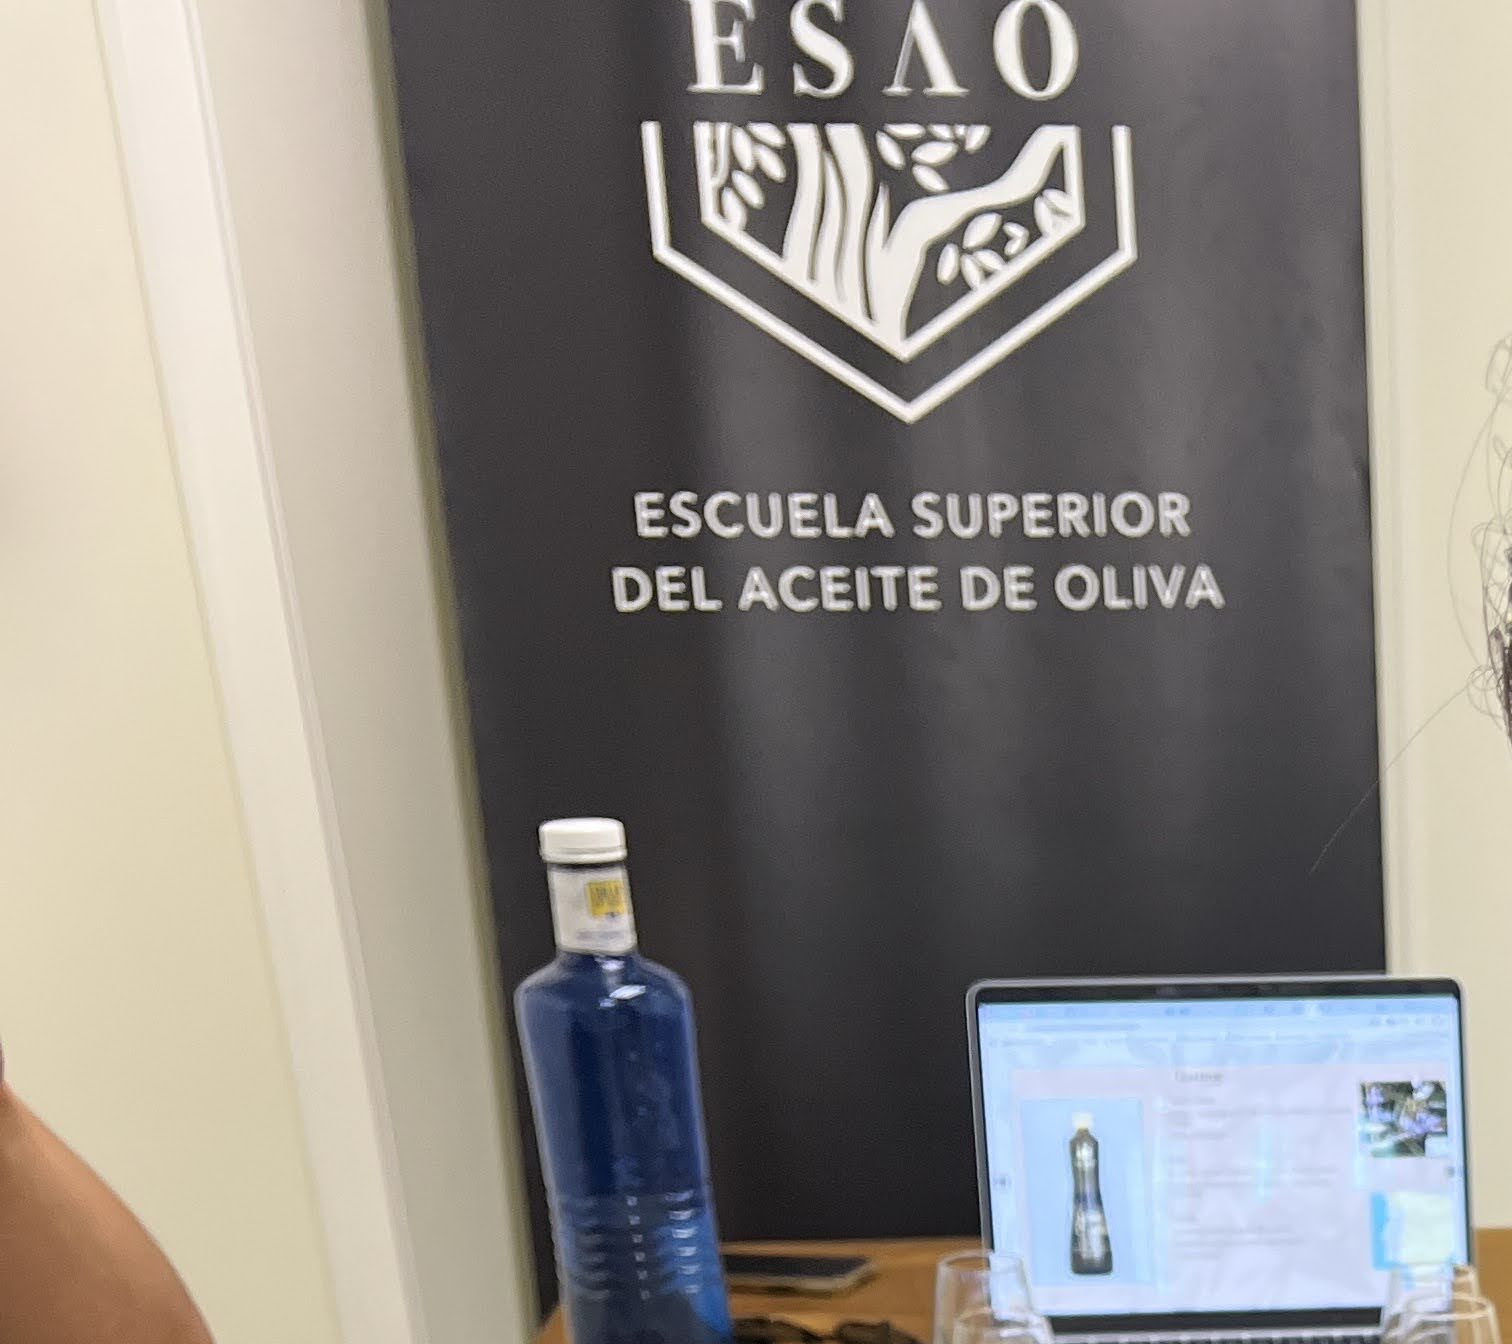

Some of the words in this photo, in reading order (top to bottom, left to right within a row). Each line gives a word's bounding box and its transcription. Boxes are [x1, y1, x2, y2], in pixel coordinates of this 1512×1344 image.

[686, 0, 1079, 99] ESAO
[633, 492, 895, 538] ESCUELA
[911, 492, 1191, 538] SUPERIOR
[611, 565, 723, 612] DEL
[737, 565, 943, 612] ACEITE
[959, 565, 1037, 612] DE
[1053, 565, 1226, 611] OLIVA
